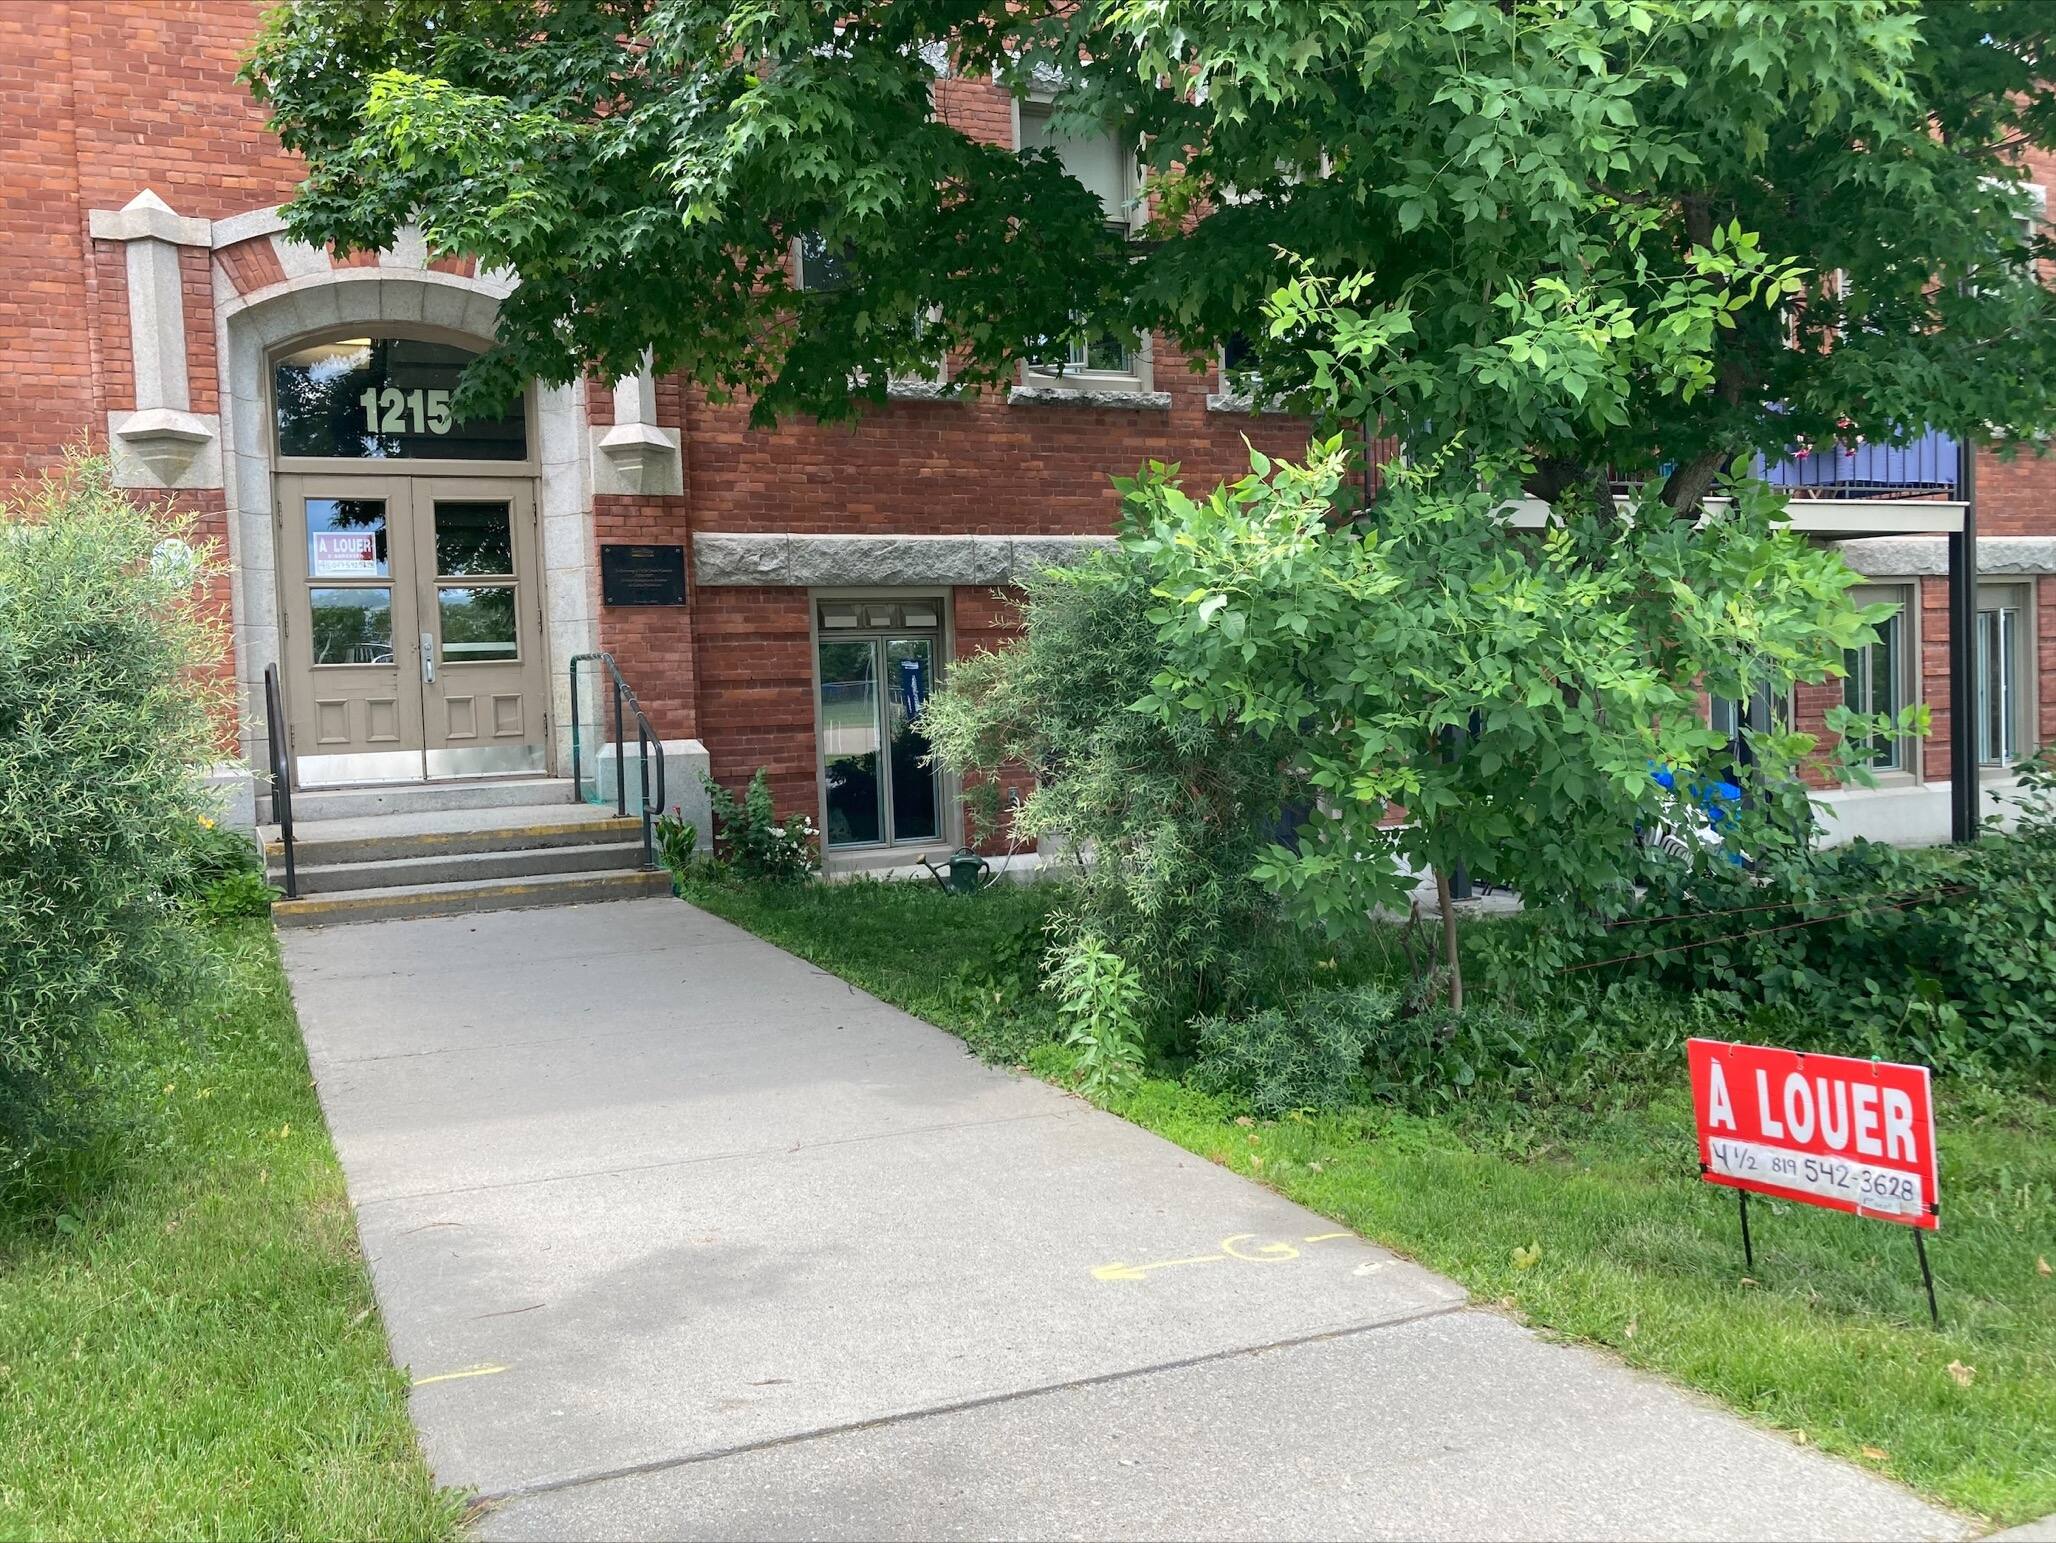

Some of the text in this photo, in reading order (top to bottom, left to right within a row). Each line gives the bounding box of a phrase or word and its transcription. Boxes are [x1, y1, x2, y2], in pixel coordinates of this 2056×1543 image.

[360, 387, 453, 435] 1215
[333, 538, 372, 553] LOUER
[1755, 1068, 1918, 1163] LOUER
[1713, 1142, 1731, 1171] 4
[1772, 1157, 1797, 1177] 819
[1803, 1158, 1914, 1201] 542-3628
